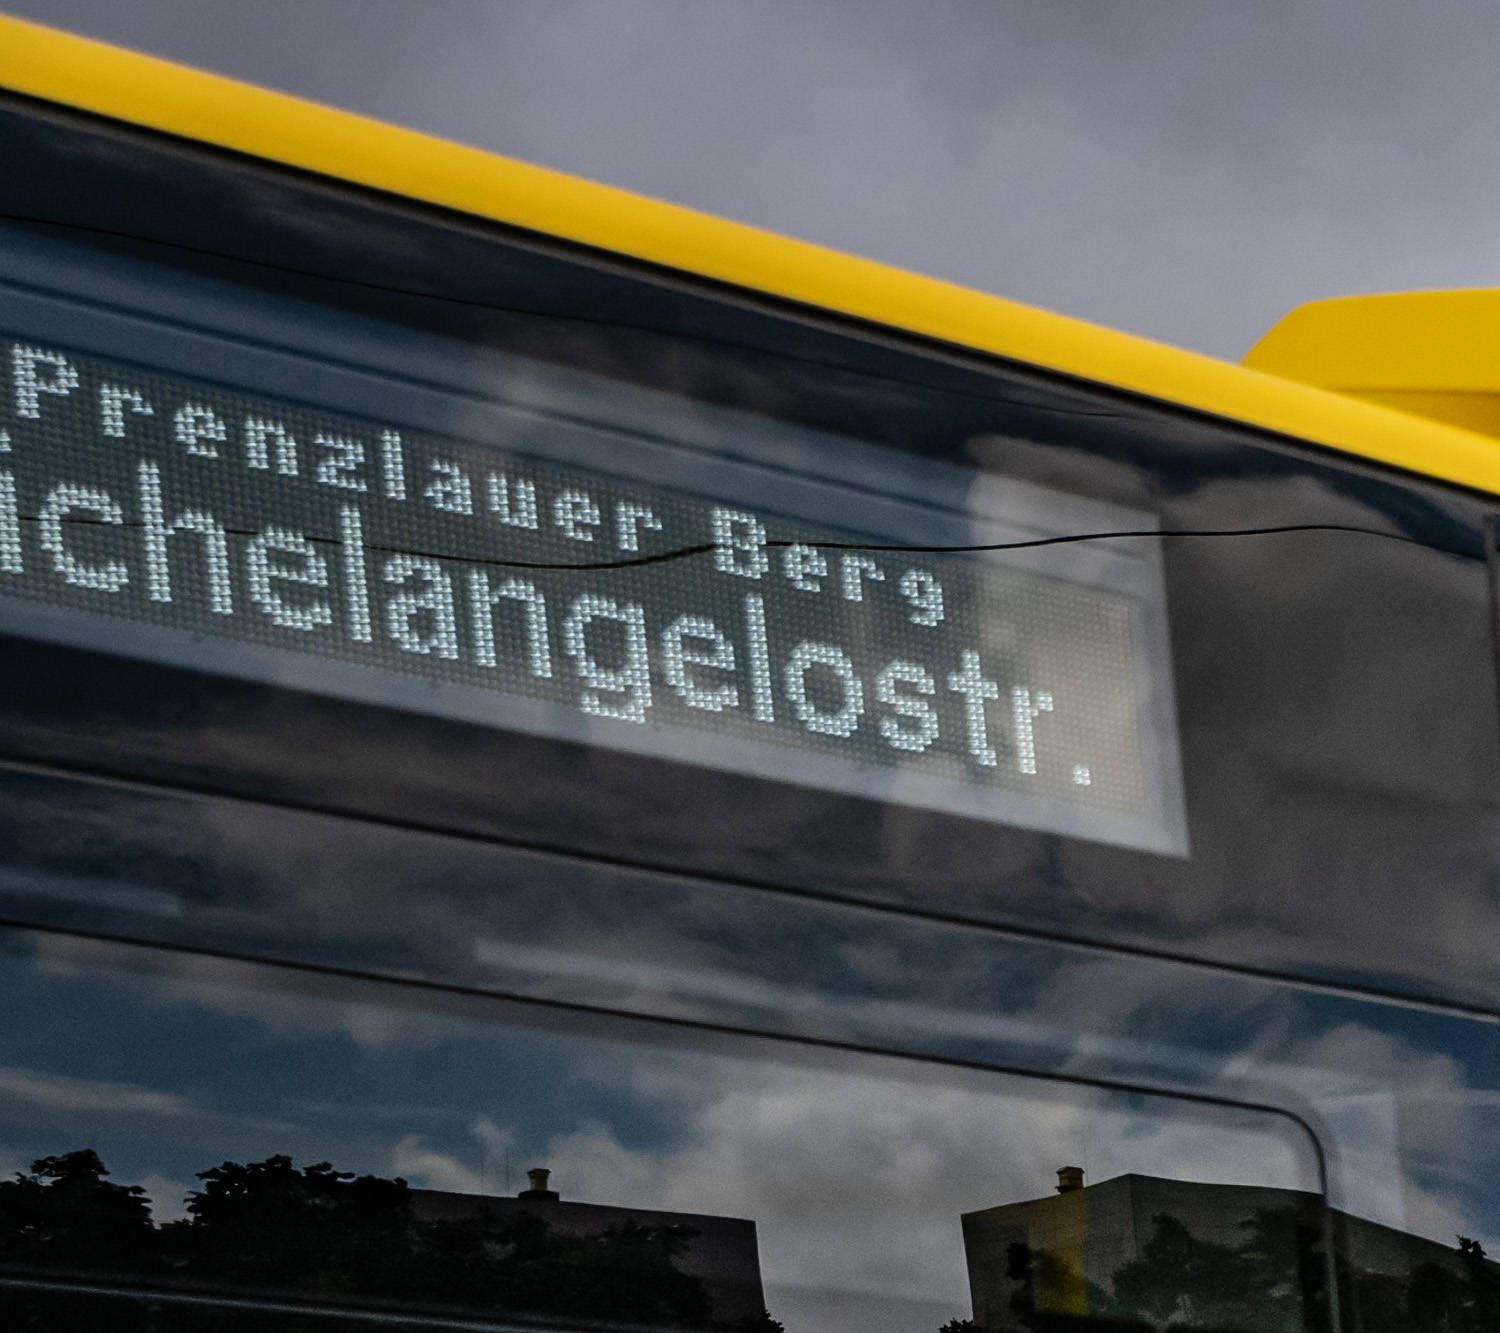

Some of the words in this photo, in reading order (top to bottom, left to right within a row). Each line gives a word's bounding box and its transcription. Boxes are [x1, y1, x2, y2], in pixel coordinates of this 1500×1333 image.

[0, 428, 1092, 785] ichelangelostr.
[12, 343, 663, 557] Prenzlauer
[711, 506, 946, 628] Berg
